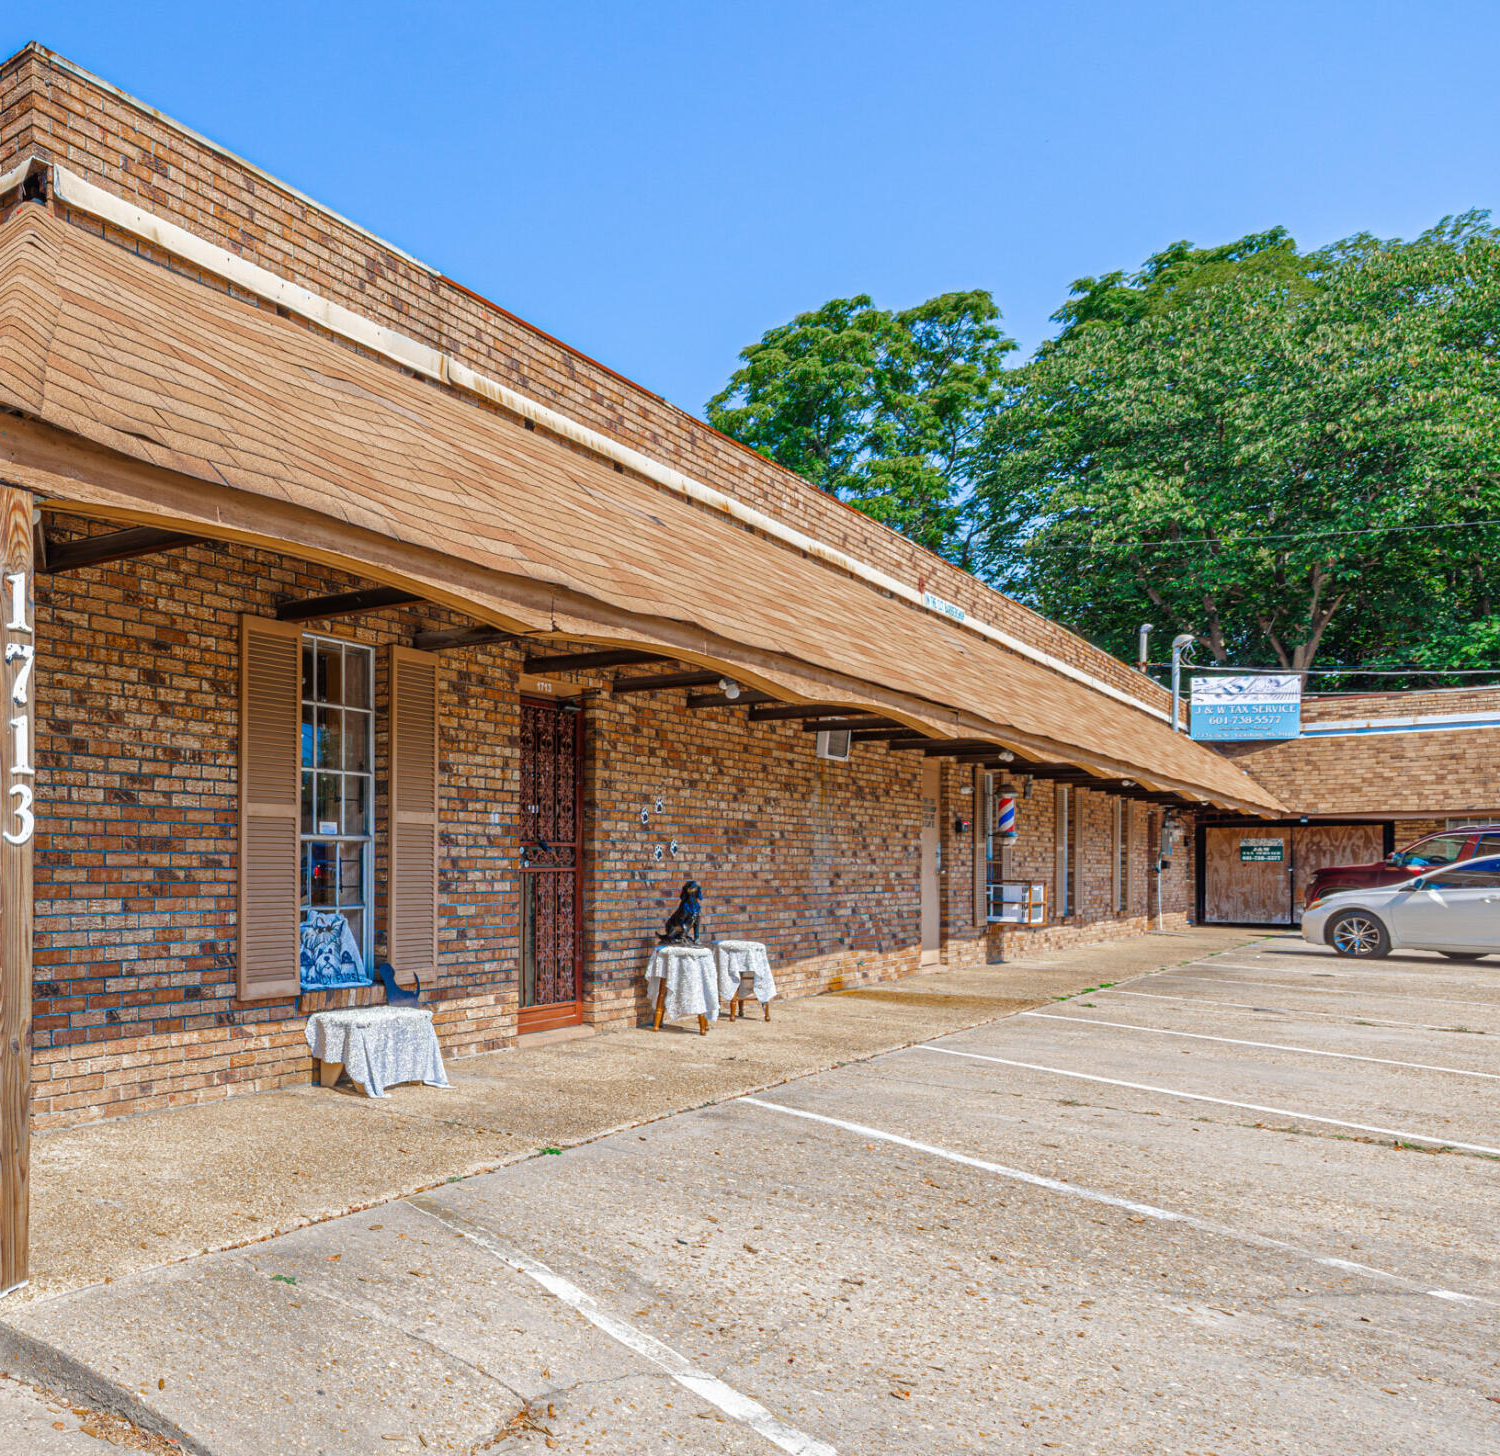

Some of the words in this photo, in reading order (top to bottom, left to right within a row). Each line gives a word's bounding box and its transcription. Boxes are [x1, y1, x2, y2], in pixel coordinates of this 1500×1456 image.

[3, 572, 35, 846] 1713
[1195, 706, 1202, 714] J
[1204, 706, 1213, 714] &
[1216, 706, 1226, 714] W
[1229, 705, 1249, 714] TAX
[1252, 704, 1296, 713] SERVICE
[1208, 715, 1282, 725] 601-738-5577
